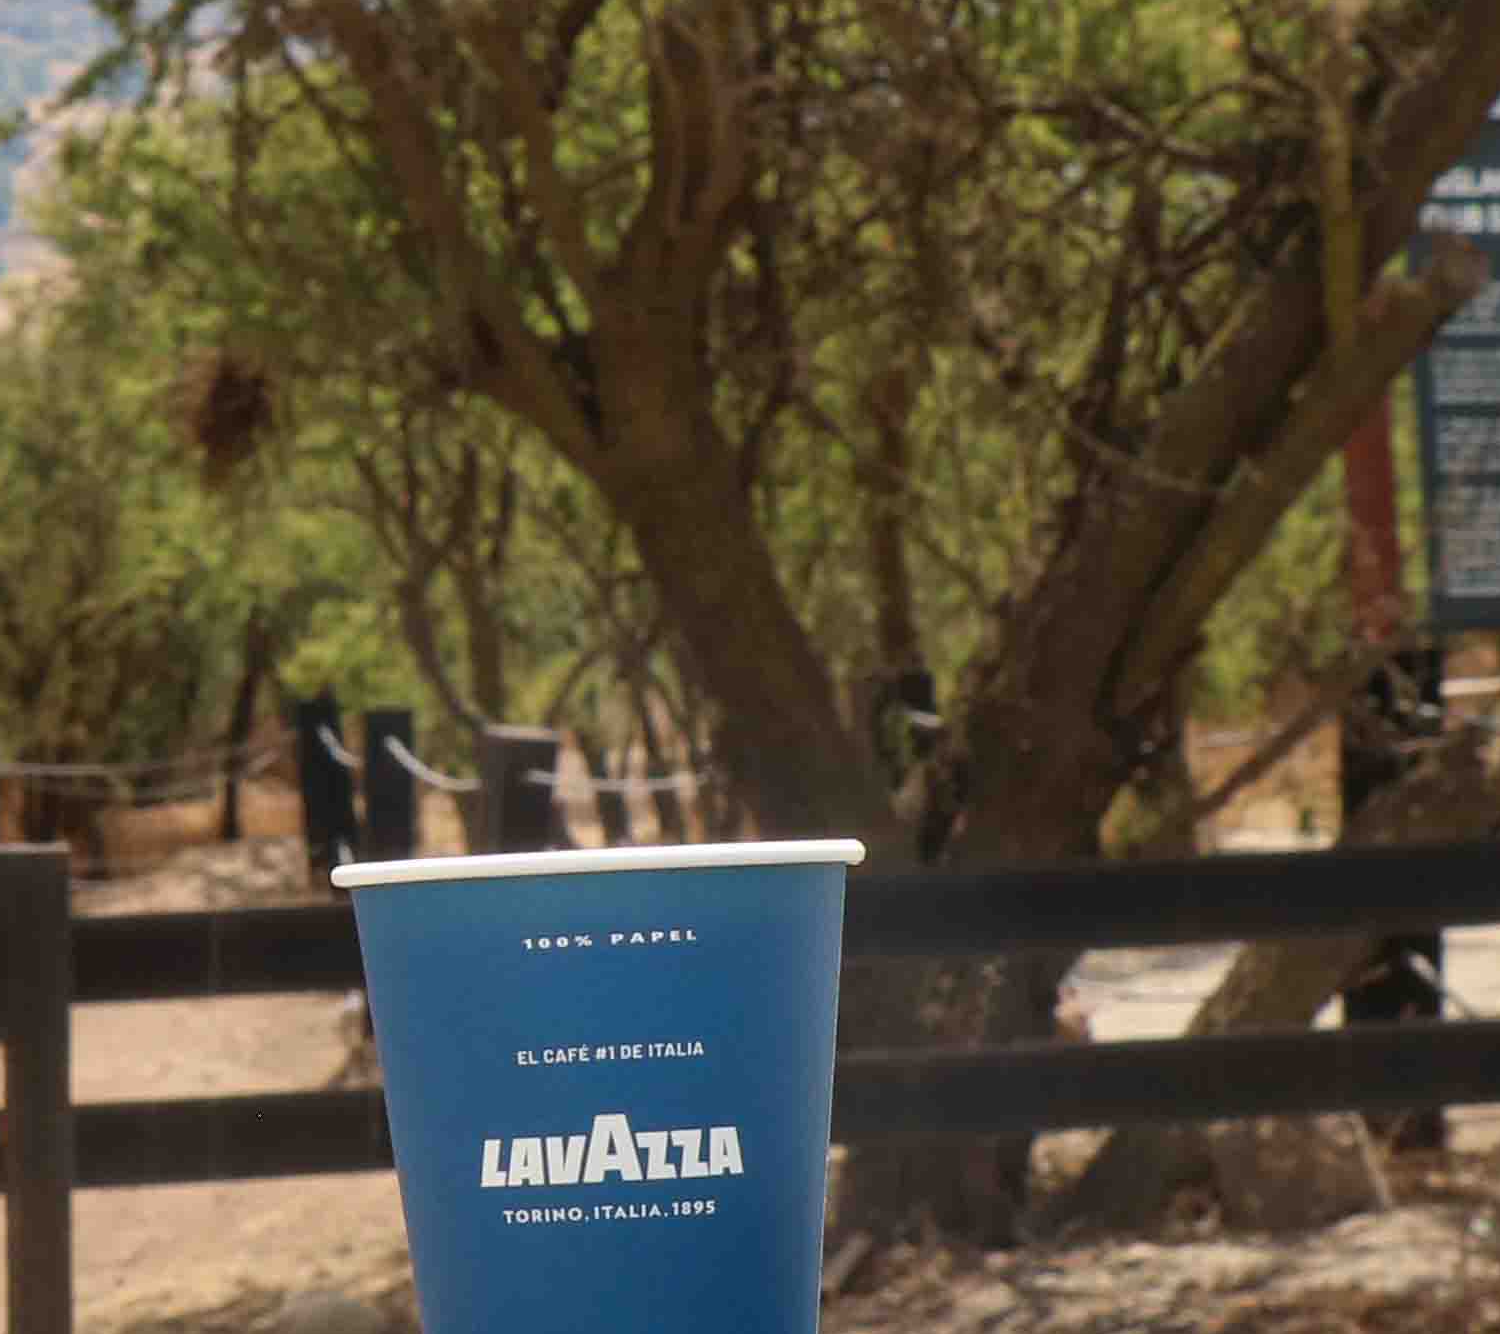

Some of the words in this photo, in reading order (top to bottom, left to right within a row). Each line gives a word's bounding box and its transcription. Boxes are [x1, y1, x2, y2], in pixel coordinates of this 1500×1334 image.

[522, 934, 594, 950] 100%
[609, 928, 697, 945] PAPEL
[517, 1050, 539, 1066] EL
[542, 1044, 591, 1064] CAFÉ
[594, 1045, 615, 1061] #1
[620, 1043, 643, 1060] DE
[648, 1040, 705, 1058] ITALIA
[671, 1199, 716, 1216] 1895
